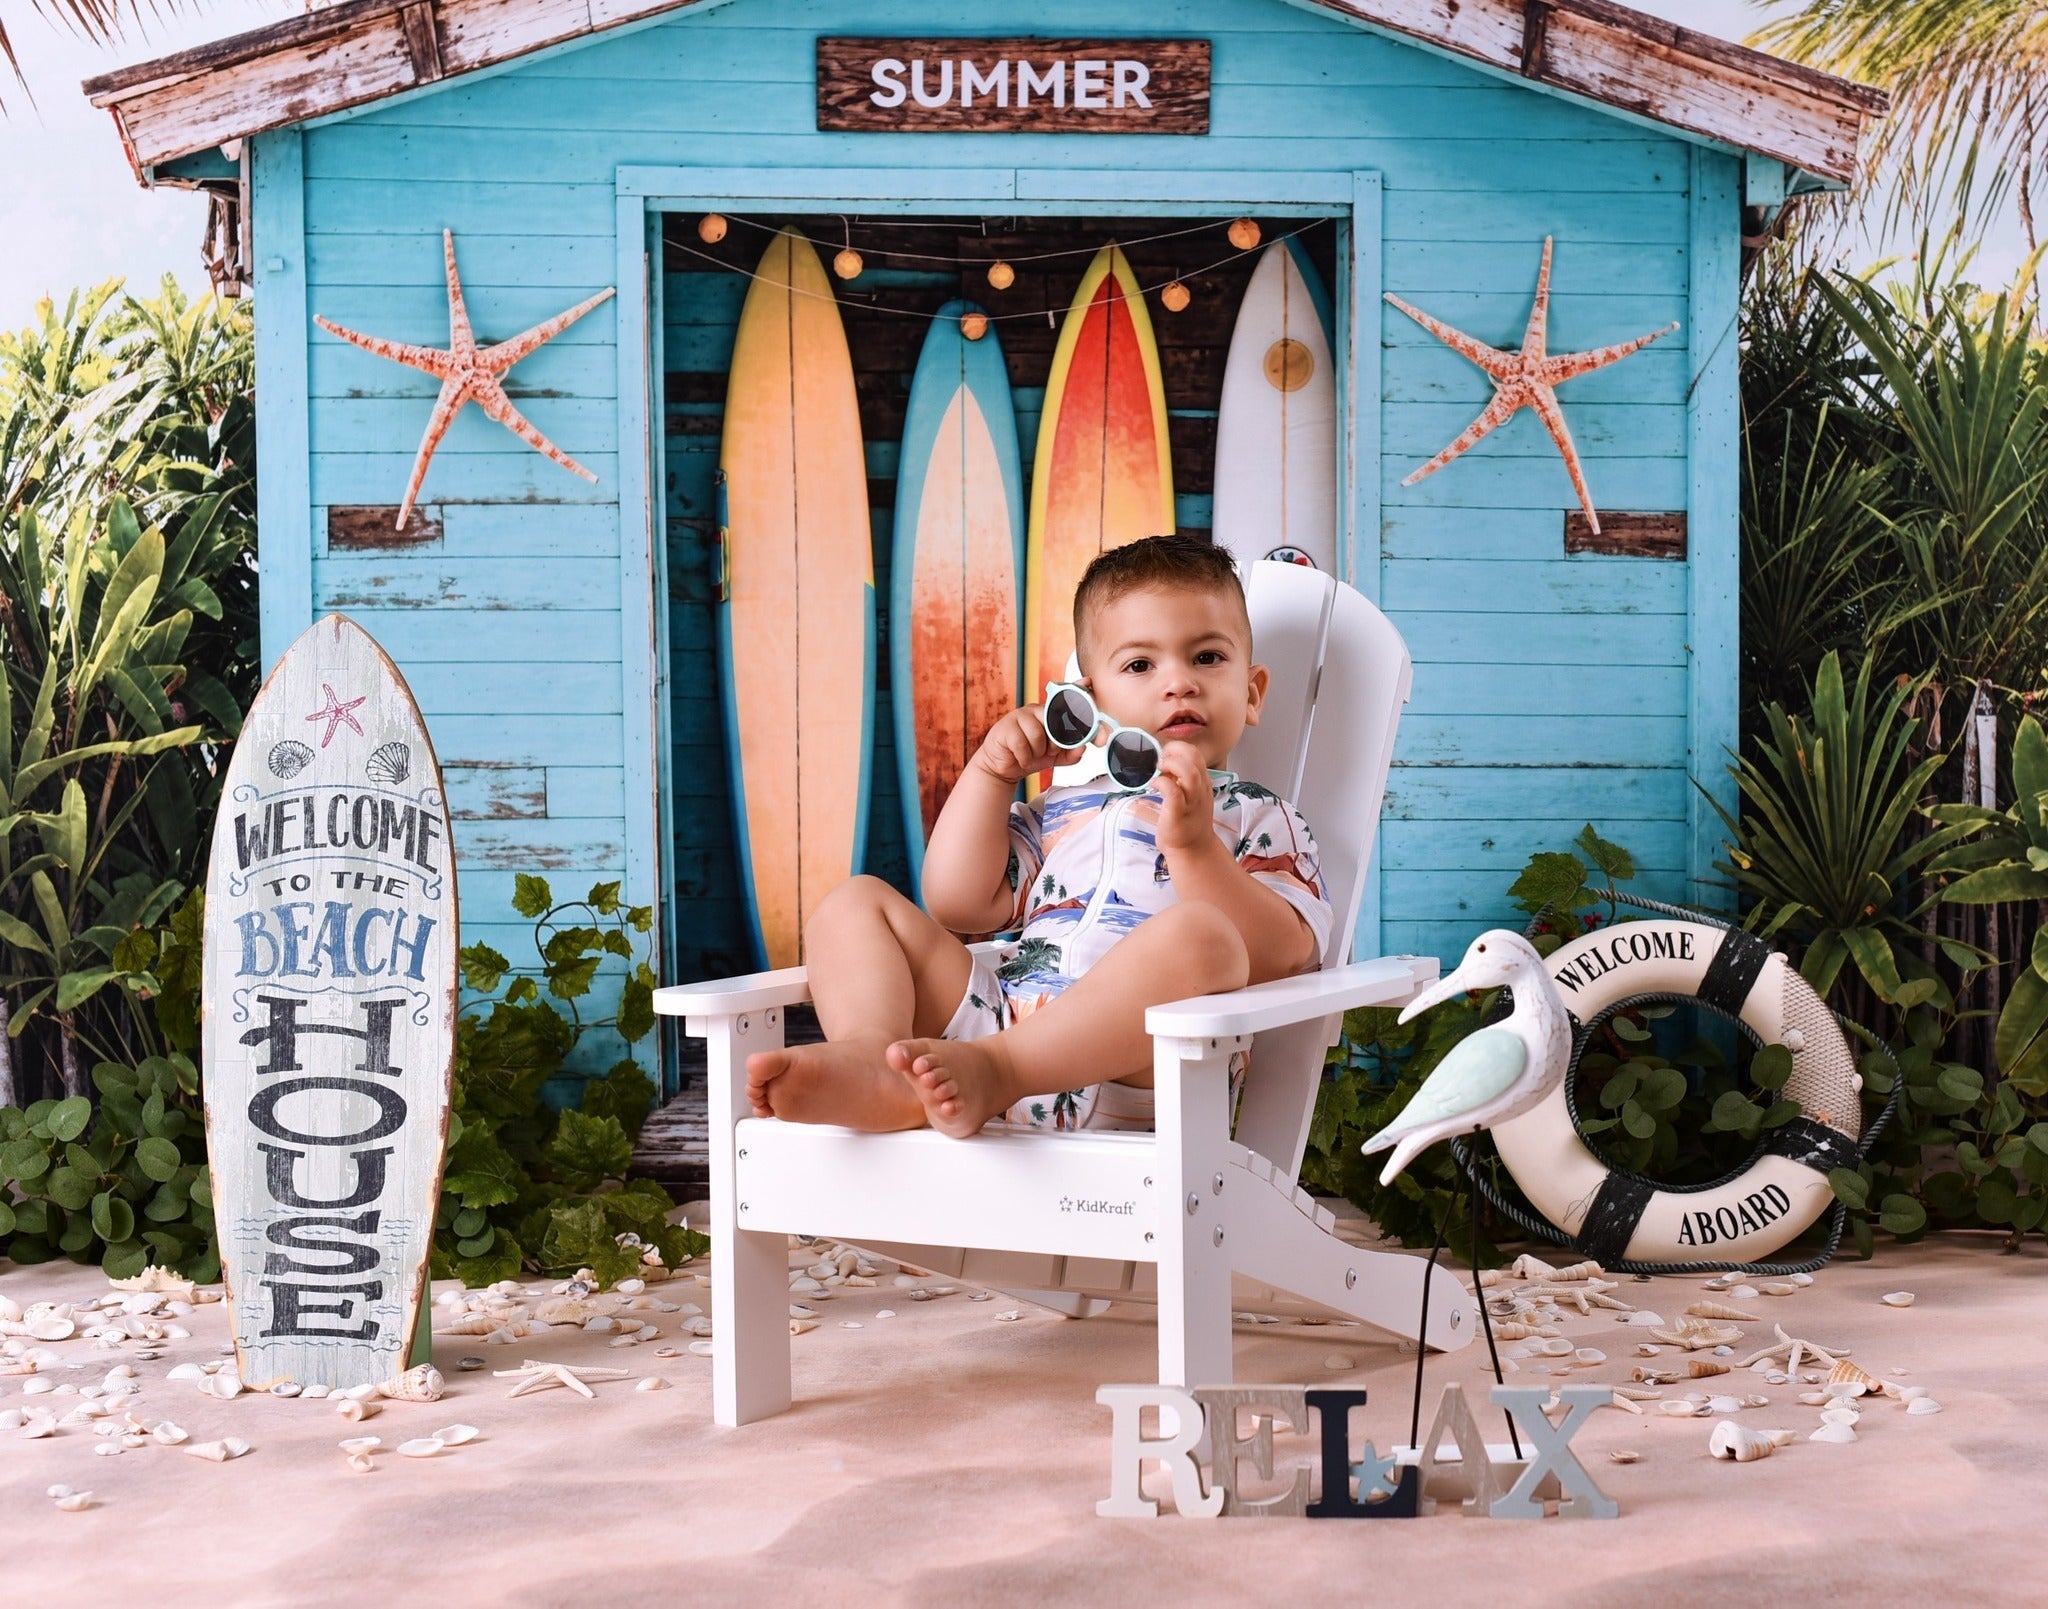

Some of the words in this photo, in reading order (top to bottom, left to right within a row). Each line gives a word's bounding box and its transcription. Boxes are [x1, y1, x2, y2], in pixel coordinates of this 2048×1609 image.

[869, 58, 1153, 108] SUMMER
[234, 793, 443, 875] WELCOME
[262, 873, 311, 897] TO
[330, 871, 409, 899] THE
[233, 901, 437, 982] BEACH
[1554, 931, 1695, 995] WELCOME
[239, 994, 408, 1341] HOUSE
[1076, 1199, 1134, 1215] KidKraft
[1677, 1183, 1792, 1246] ABOARD
[1095, 1382, 1620, 1519] RELAX
